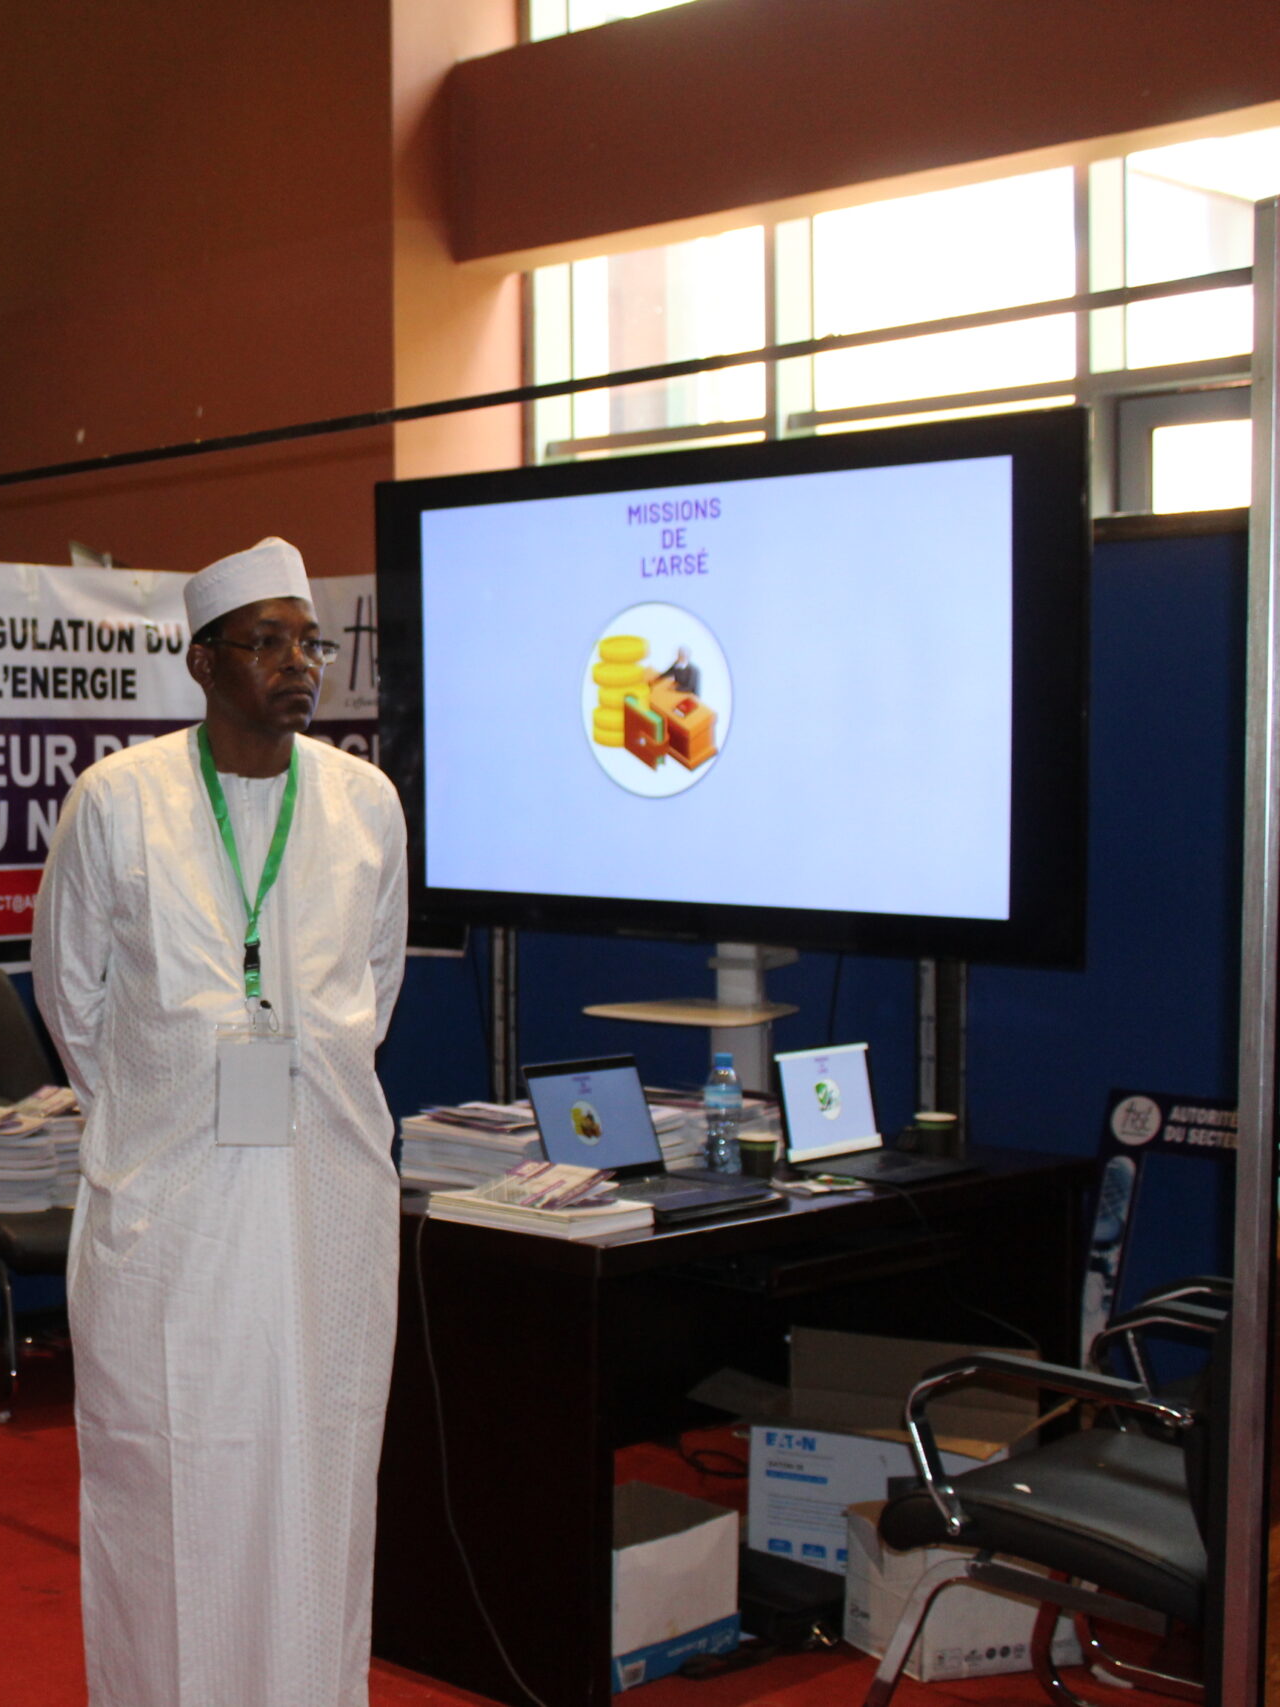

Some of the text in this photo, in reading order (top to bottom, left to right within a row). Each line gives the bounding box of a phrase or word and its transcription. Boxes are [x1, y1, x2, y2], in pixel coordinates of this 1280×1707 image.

[628, 498, 721, 525] MISSIONS
[661, 528, 687, 549] DE
[642, 548, 709, 578] L'ARSÉ
[145, 624, 183, 654] DU
[1163, 1125, 1186, 1143] DU
